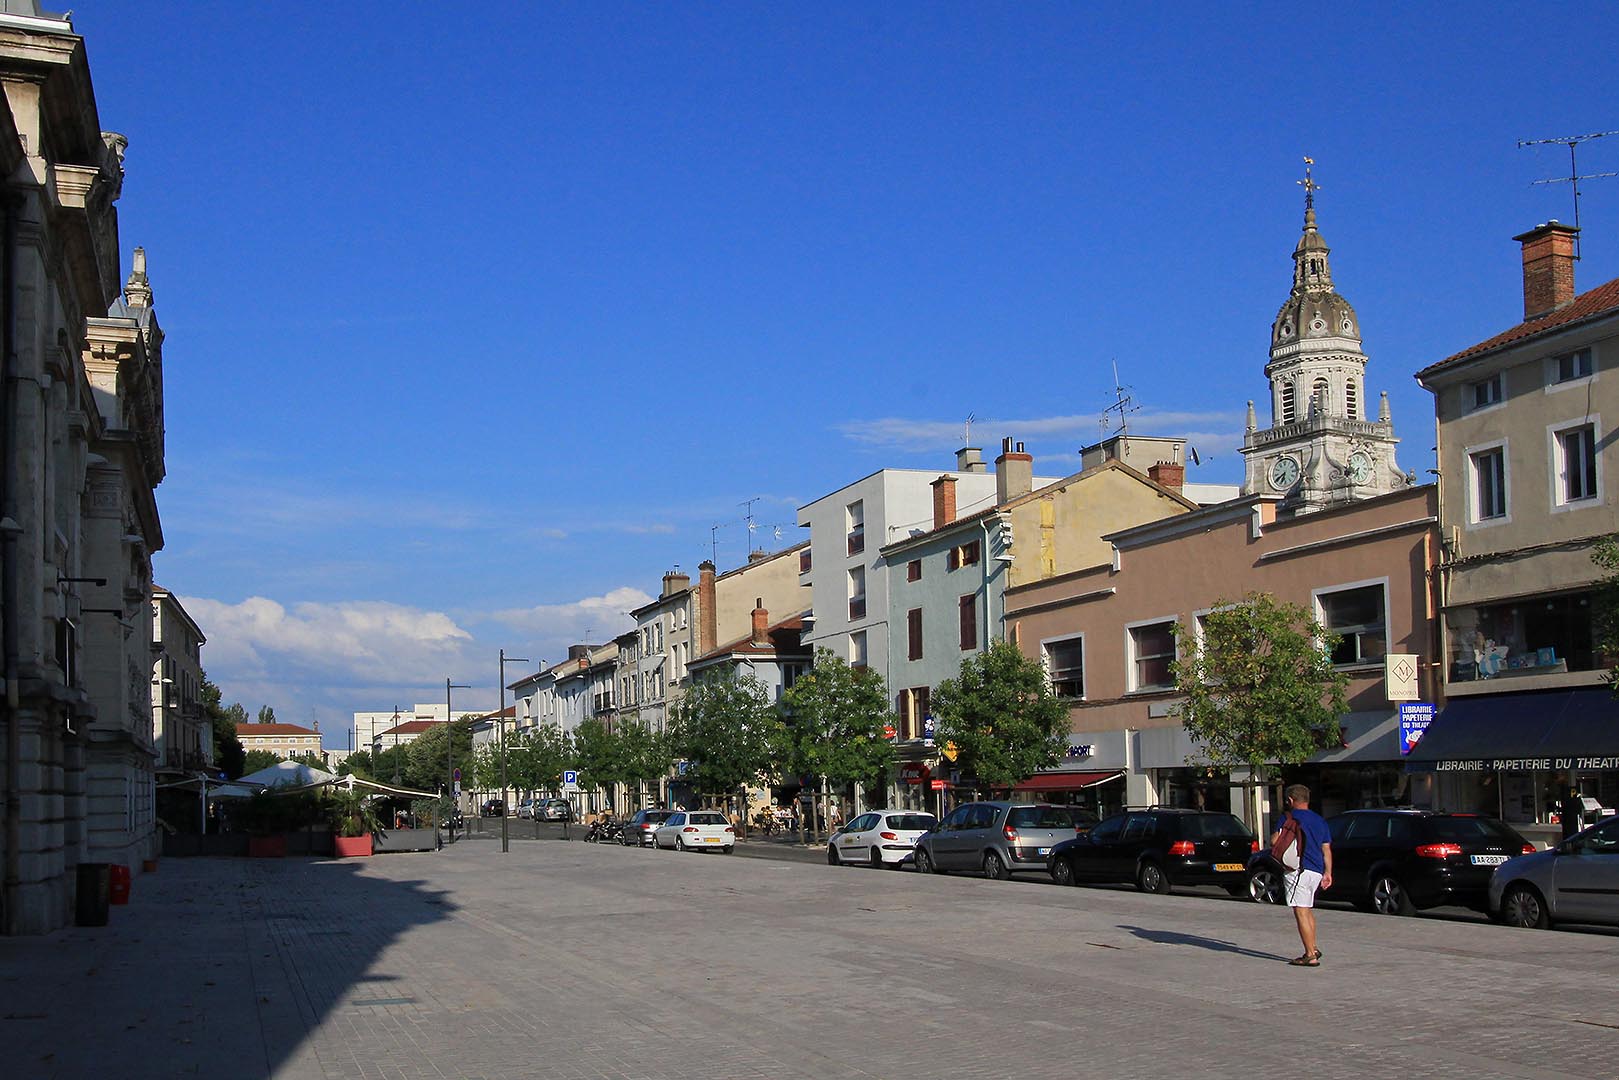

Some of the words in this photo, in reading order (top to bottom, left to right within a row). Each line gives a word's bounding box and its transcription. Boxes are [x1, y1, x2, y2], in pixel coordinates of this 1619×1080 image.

[1398, 666, 1409, 677] M
[1402, 706, 1433, 714] LIBRAIRIE
[1402, 714, 1433, 722] PAPETERIE
[1436, 760, 1484, 771] LIBRAIRIE
[1493, 759, 1551, 770] PAPETERIE
[1555, 758, 1572, 769] DU
